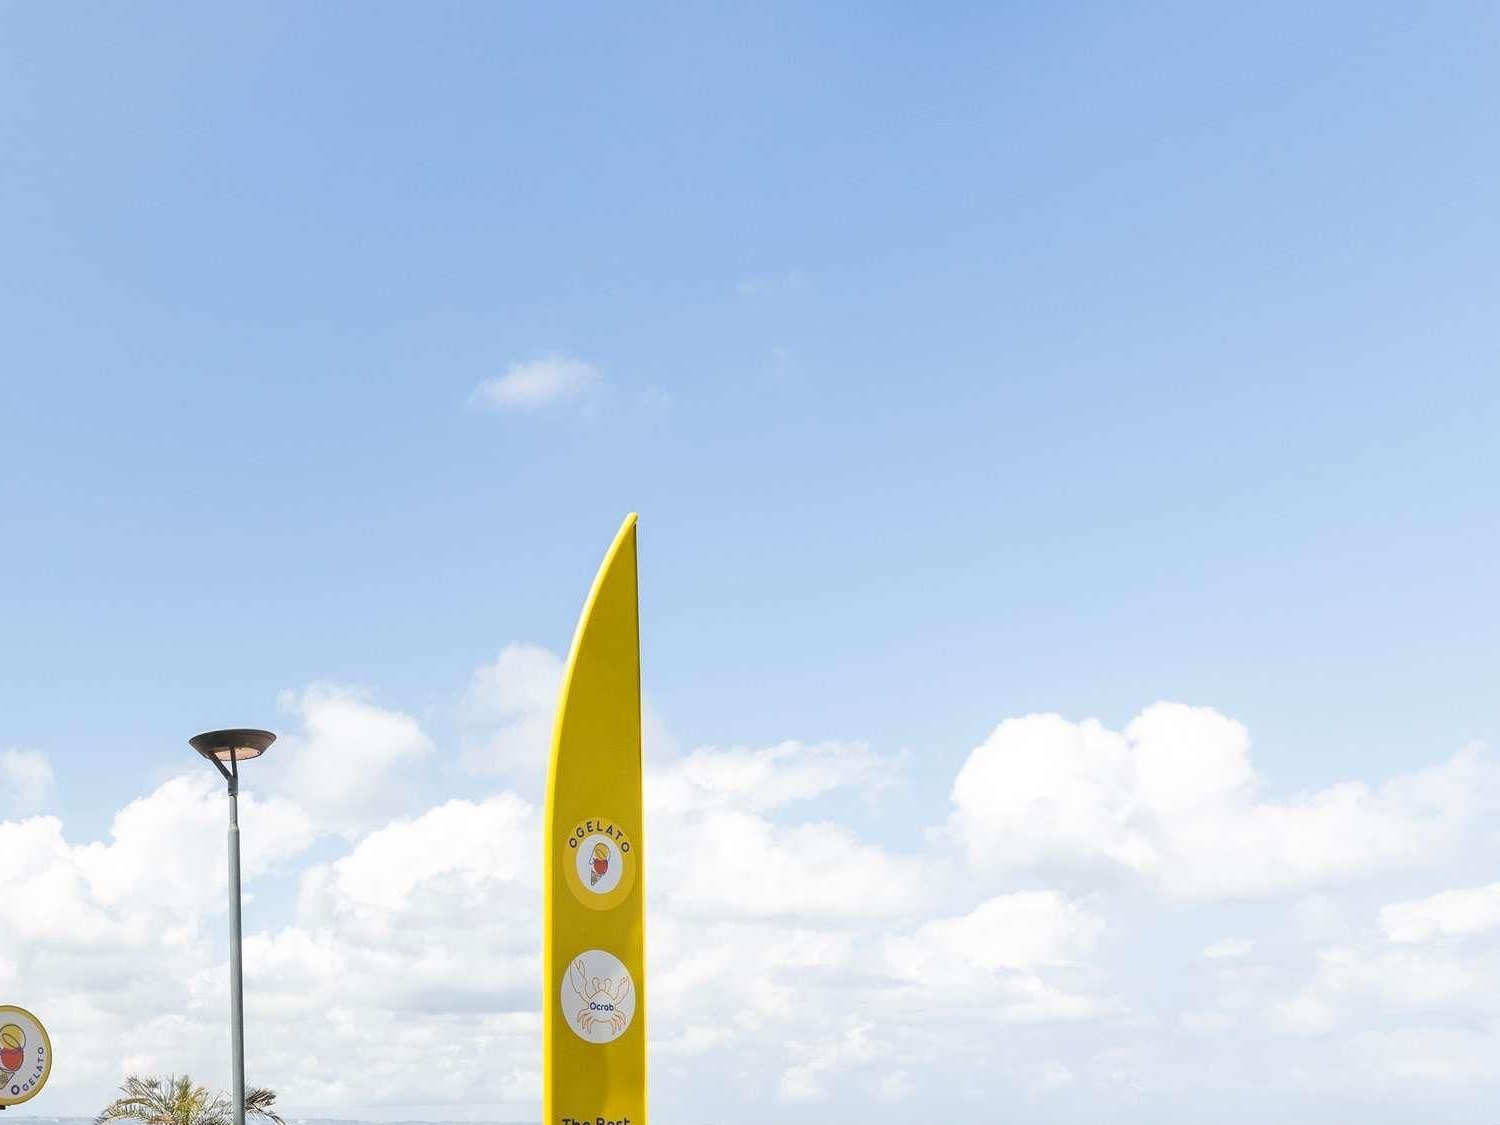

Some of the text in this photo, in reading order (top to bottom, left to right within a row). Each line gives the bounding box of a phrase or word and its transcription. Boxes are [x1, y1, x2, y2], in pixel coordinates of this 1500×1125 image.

[569, 820, 630, 853] OGELATO
[590, 1001, 614, 1011] Ocrab
[11, 1047, 44, 1095] OGELATO
